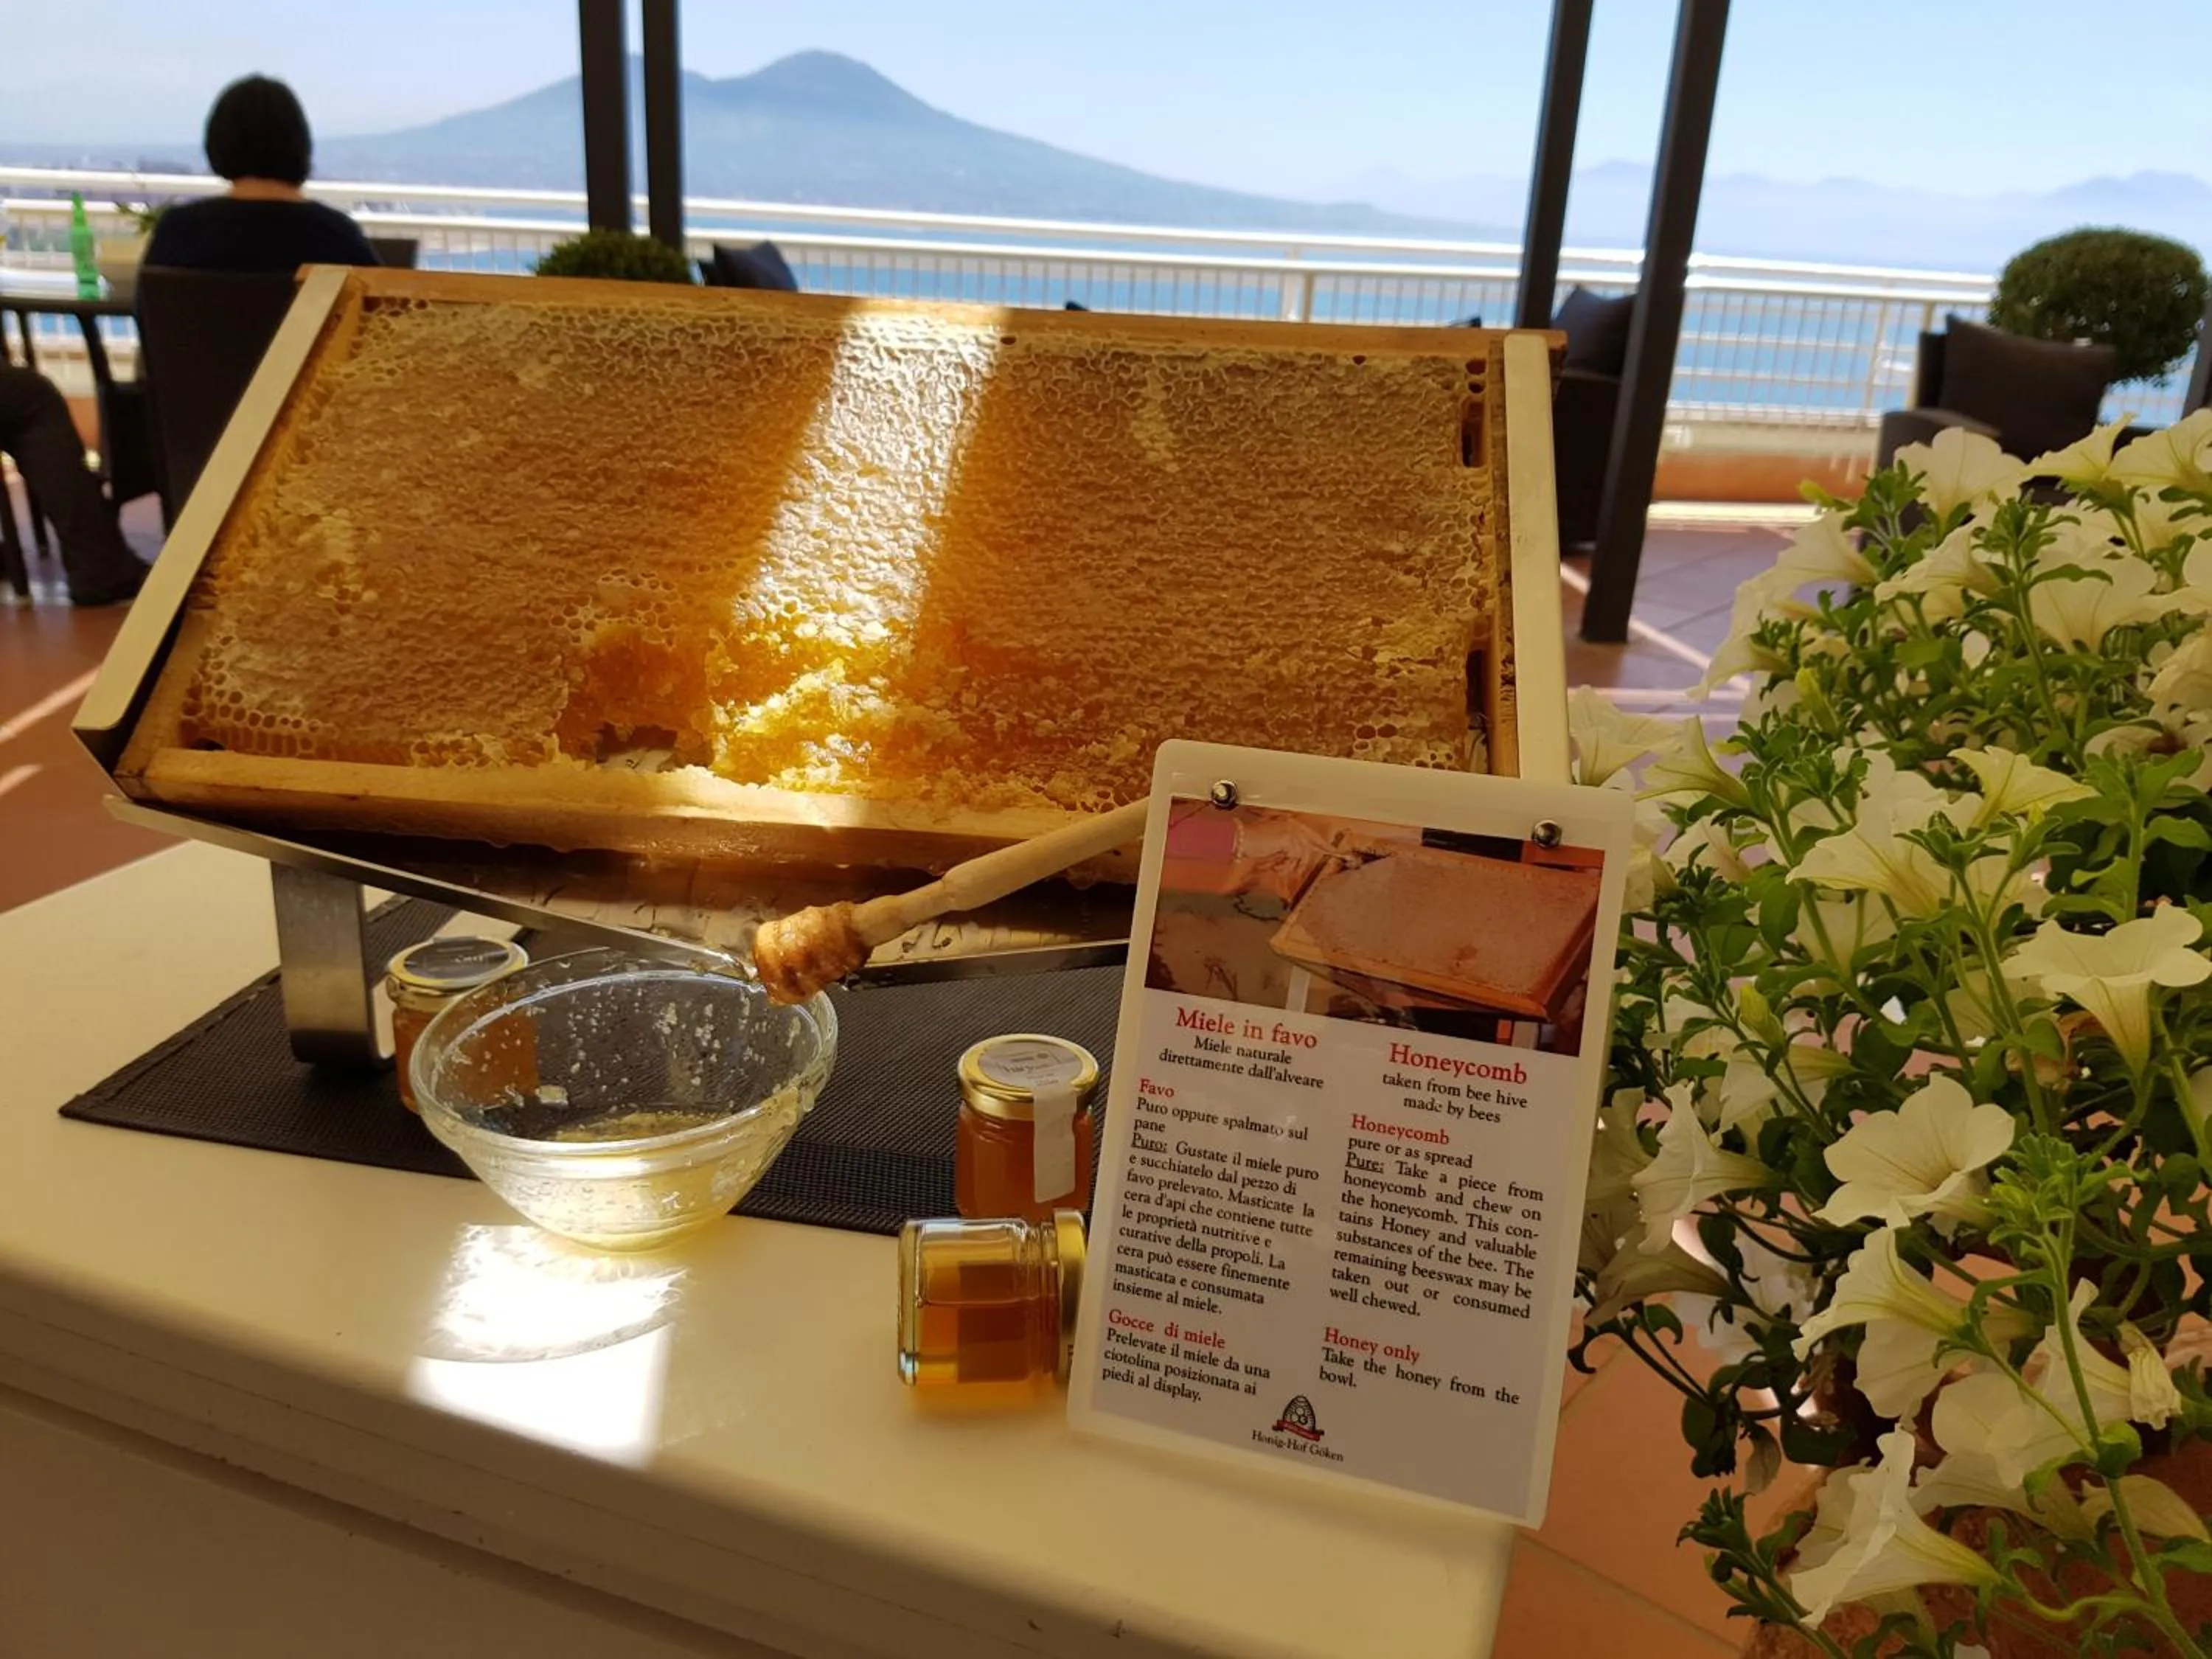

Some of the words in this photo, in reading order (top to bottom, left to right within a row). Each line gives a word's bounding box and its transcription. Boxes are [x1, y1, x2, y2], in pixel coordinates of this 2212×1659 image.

[1176, 1007, 1234, 1034] Miele
[1243, 1020, 1262, 1040] in
[1272, 1023, 1317, 1048] favo
[1159, 1048, 1244, 1074] direttamente
[1248, 1063, 1324, 1088] dall'alveare
[1194, 1035, 1231, 1054] Miele
[1237, 1047, 1292, 1064] naturale
[1389, 1042, 1527, 1084] Honeycomb
[1139, 1079, 1174, 1097] Favo
[1382, 1073, 1421, 1090] taken
[1427, 1078, 1461, 1097] from
[1467, 1085, 1491, 1102] bee
[1496, 1090, 1528, 1108] hive
[1134, 1119, 1165, 1133] pane
[1136, 1097, 1168, 1115] Puro
[1172, 1108, 1218, 1124] oppure
[1223, 1116, 1284, 1135] spalmato
[1288, 1124, 1308, 1141] sul
[1352, 1113, 1449, 1144] Honeycomb
[1404, 1097, 1442, 1112] made
[1447, 1100, 1464, 1119] by
[1469, 1104, 1500, 1123] bees
[1131, 1133, 1167, 1153] Puro:
[1176, 1141, 1227, 1163] Gustate
[1233, 1152, 1241, 1165] il
[1245, 1158, 1281, 1173] miele
[1286, 1166, 1319, 1183] puro
[1348, 1138, 1380, 1151] pure
[1385, 1144, 1401, 1155] or
[1405, 1148, 1419, 1158] as
[1425, 1152, 1472, 1168] spread
[1127, 1168, 1154, 1186] favo
[1158, 1178, 1223, 1200] prelevato.
[1227, 1192, 1294, 1214] Masticate
[1303, 1203, 1315, 1217] la
[1129, 1155, 1136, 1164] e
[1141, 1158, 1213, 1178] succhiatelo
[1217, 1168, 1237, 1183] dal
[1242, 1177, 1279, 1192] pezzo
[1283, 1180, 1296, 1195] di
[1343, 1170, 1426, 1197] honeycomb
[1436, 1192, 1464, 1206] and
[1472, 1196, 1512, 1214] chew
[1522, 1209, 1541, 1221] on
[1345, 1152, 1384, 1174] Pure:
[1395, 1161, 1428, 1179] Take
[1439, 1173, 1447, 1183] a
[1458, 1175, 1496, 1192] piece
[1508, 1181, 1543, 1201] from
[1122, 1203, 1133, 1218] le
[1137, 1211, 1197, 1233] proprietà
[1202, 1225, 1260, 1245] nutritive
[1265, 1239, 1272, 1248] e
[1124, 1191, 1150, 1203] cera
[1155, 1193, 1186, 1212] d'api
[1189, 1200, 1212, 1216] che
[1217, 1209, 1275, 1231] contiene
[1280, 1221, 1312, 1237] tutte
[1339, 1211, 1373, 1227] tains
[1381, 1215, 1430, 1241] Honey
[1439, 1231, 1467, 1246] and
[1475, 1237, 1537, 1259] valuable
[1342, 1190, 1364, 1206] the
[1370, 1194, 1457, 1224] honeycomb.
[1466, 1212, 1498, 1232] This
[1506, 1225, 1539, 1239] con-
[1117, 1245, 1143, 1259] cera
[1147, 1248, 1172, 1265] può
[1177, 1258, 1217, 1274] essere
[1221, 1263, 1290, 1290] finemente
[1119, 1227, 1172, 1245] curative
[1175, 1235, 1206, 1253] della
[1211, 1246, 1263, 1265] propoli.
[1269, 1253, 1285, 1270] La
[1336, 1230, 1413, 1256] substances
[1418, 1245, 1435, 1259] of
[1439, 1248, 1461, 1265] the
[1468, 1253, 1497, 1272] bee.
[1504, 1260, 1534, 1279] The
[1116, 1263, 1175, 1284] masticata
[1180, 1278, 1187, 1287] e
[1192, 1280, 1264, 1304] consumata
[1332, 1267, 1370, 1285] taken
[1385, 1281, 1409, 1294] out
[1423, 1289, 1439, 1300] or
[1453, 1295, 1530, 1318] consumed
[1334, 1251, 1407, 1276] remaining
[1412, 1264, 1473, 1287] beeswax
[1478, 1279, 1509, 1298] may
[1514, 1282, 1531, 1299] be
[1113, 1279, 1162, 1300] insieme
[1166, 1290, 1178, 1304] al
[1182, 1296, 1222, 1315] miele.
[1330, 1287, 1357, 1303] well
[1362, 1292, 1420, 1316] chewed.
[1109, 1310, 1154, 1332] Gocce
[1164, 1322, 1178, 1338] di
[1184, 1330, 1225, 1349] miele
[1324, 1327, 1378, 1356] Honey
[1383, 1345, 1419, 1366] only
[1105, 1348, 1160, 1371] ciotolina
[1164, 1364, 1239, 1391] posizionata
[1245, 1382, 1256, 1395] ai
[1107, 1327, 1166, 1354] Prelevate
[1170, 1343, 1179, 1357] il
[1183, 1349, 1220, 1366] miele
[1224, 1357, 1239, 1371] da
[1245, 1365, 1270, 1379] una
[1102, 1367, 1134, 1384] piedi
[1138, 1374, 1150, 1388] al
[1154, 1377, 1201, 1402] display.
[1319, 1366, 1356, 1387] bowl.
[1322, 1346, 1354, 1367] Take
[1364, 1357, 1386, 1374] the
[1396, 1363, 1441, 1389] honey
[1450, 1376, 1485, 1397] from
[1495, 1387, 1519, 1404] the
